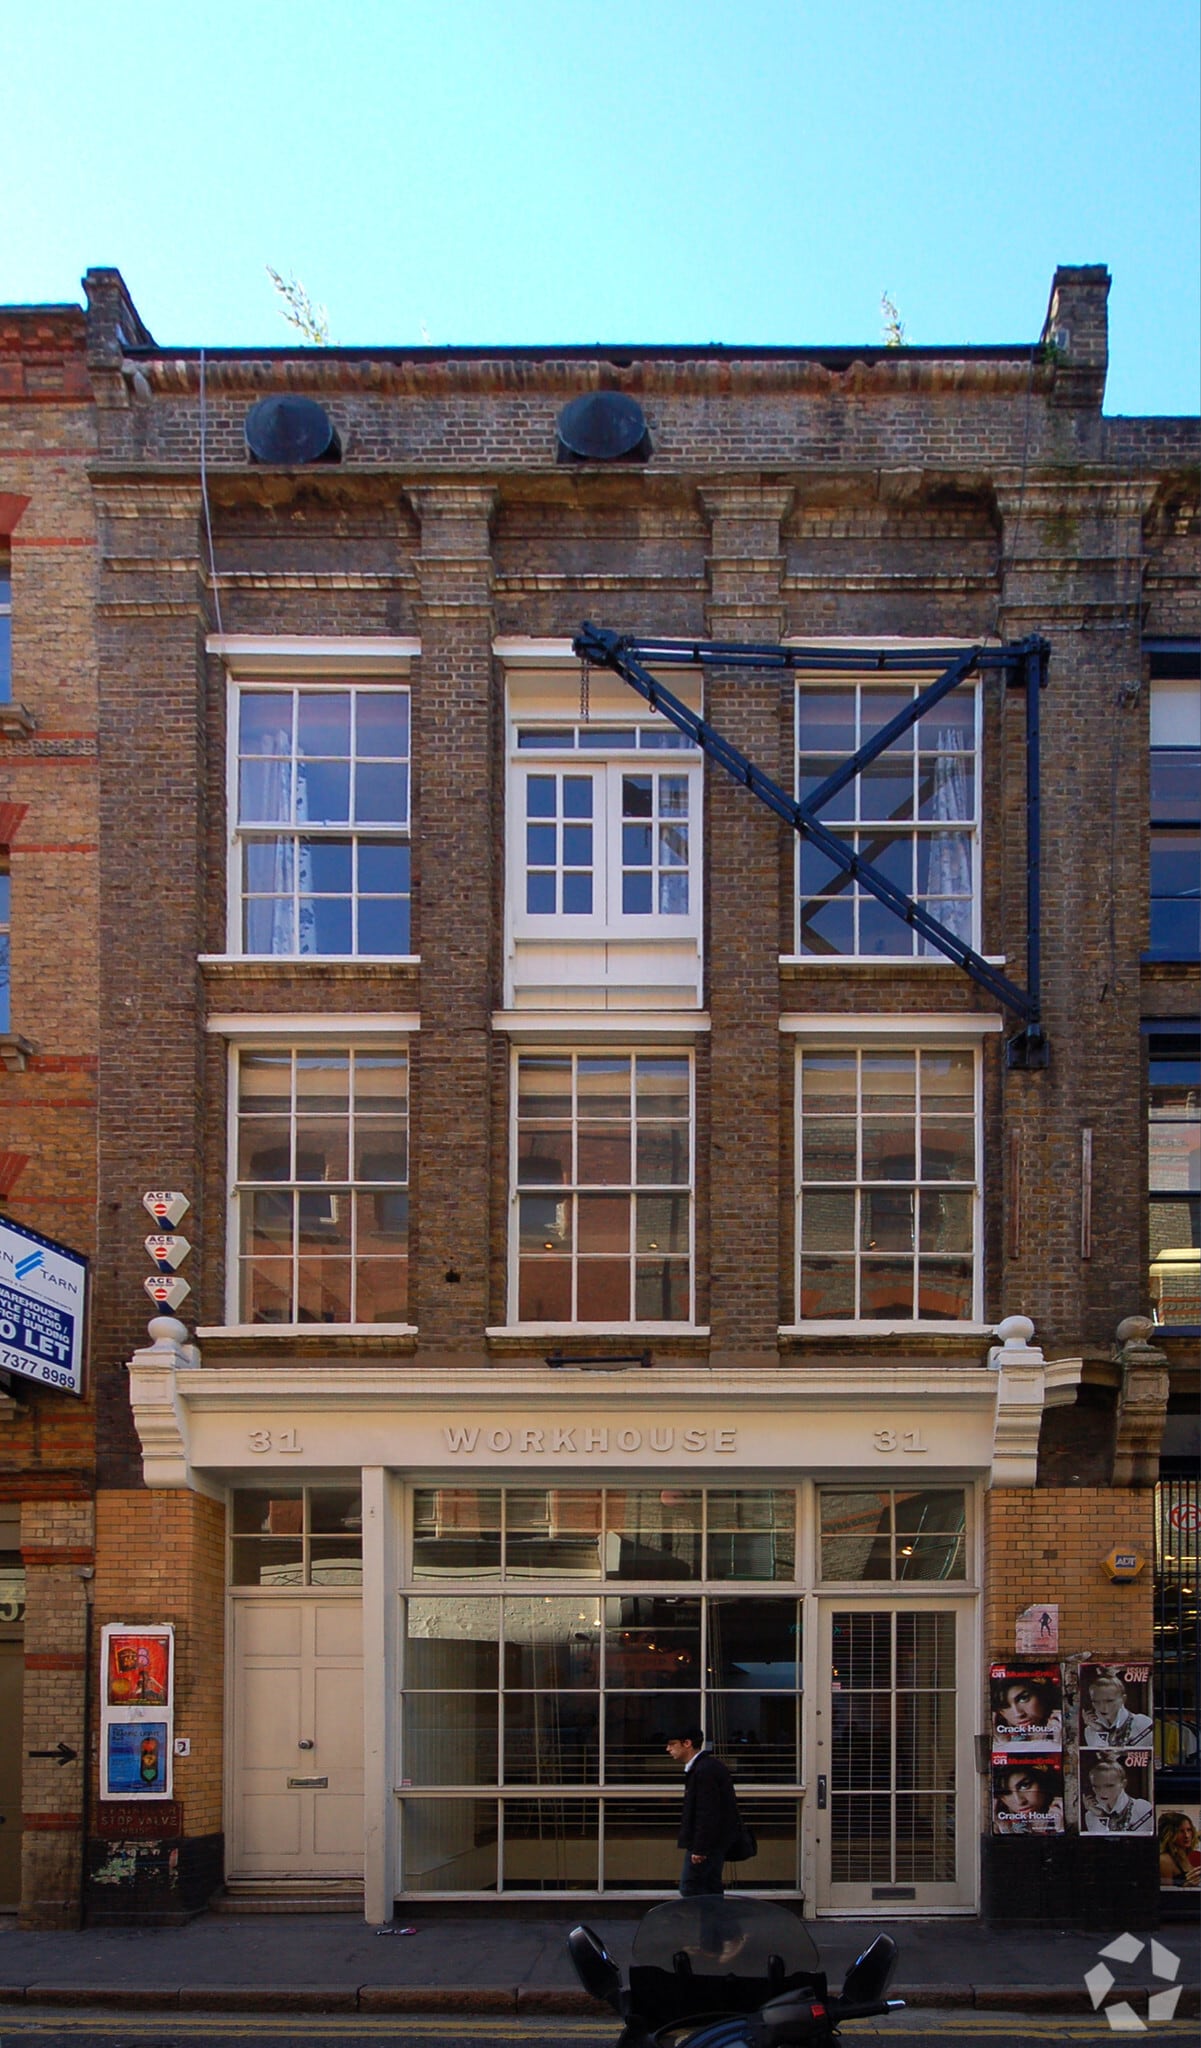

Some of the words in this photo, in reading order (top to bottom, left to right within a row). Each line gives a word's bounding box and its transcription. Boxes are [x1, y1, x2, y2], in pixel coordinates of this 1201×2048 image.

[40, 1268, 78, 1294] TARN
[24, 1309, 62, 1331] STUDIO
[23, 1317, 70, 1344] BUILDING
[25, 1329, 70, 1361] LET
[2, 1349, 38, 1374] 7377
[42, 1366, 76, 1389] 8989
[247, 1428, 304, 1454] 31
[444, 1427, 738, 1454] WORKHOUSE
[872, 1427, 928, 1454] 31
[1116, 1557, 1135, 1566] ADT
[1124, 1672, 1149, 1682] ONE
[997, 1725, 1026, 1733] Crack
[1125, 1757, 1149, 1767] ONE
[101, 1816, 133, 1825] STOP
[138, 1816, 177, 1825] VALVE
[998, 1812, 1027, 1820] Crack
